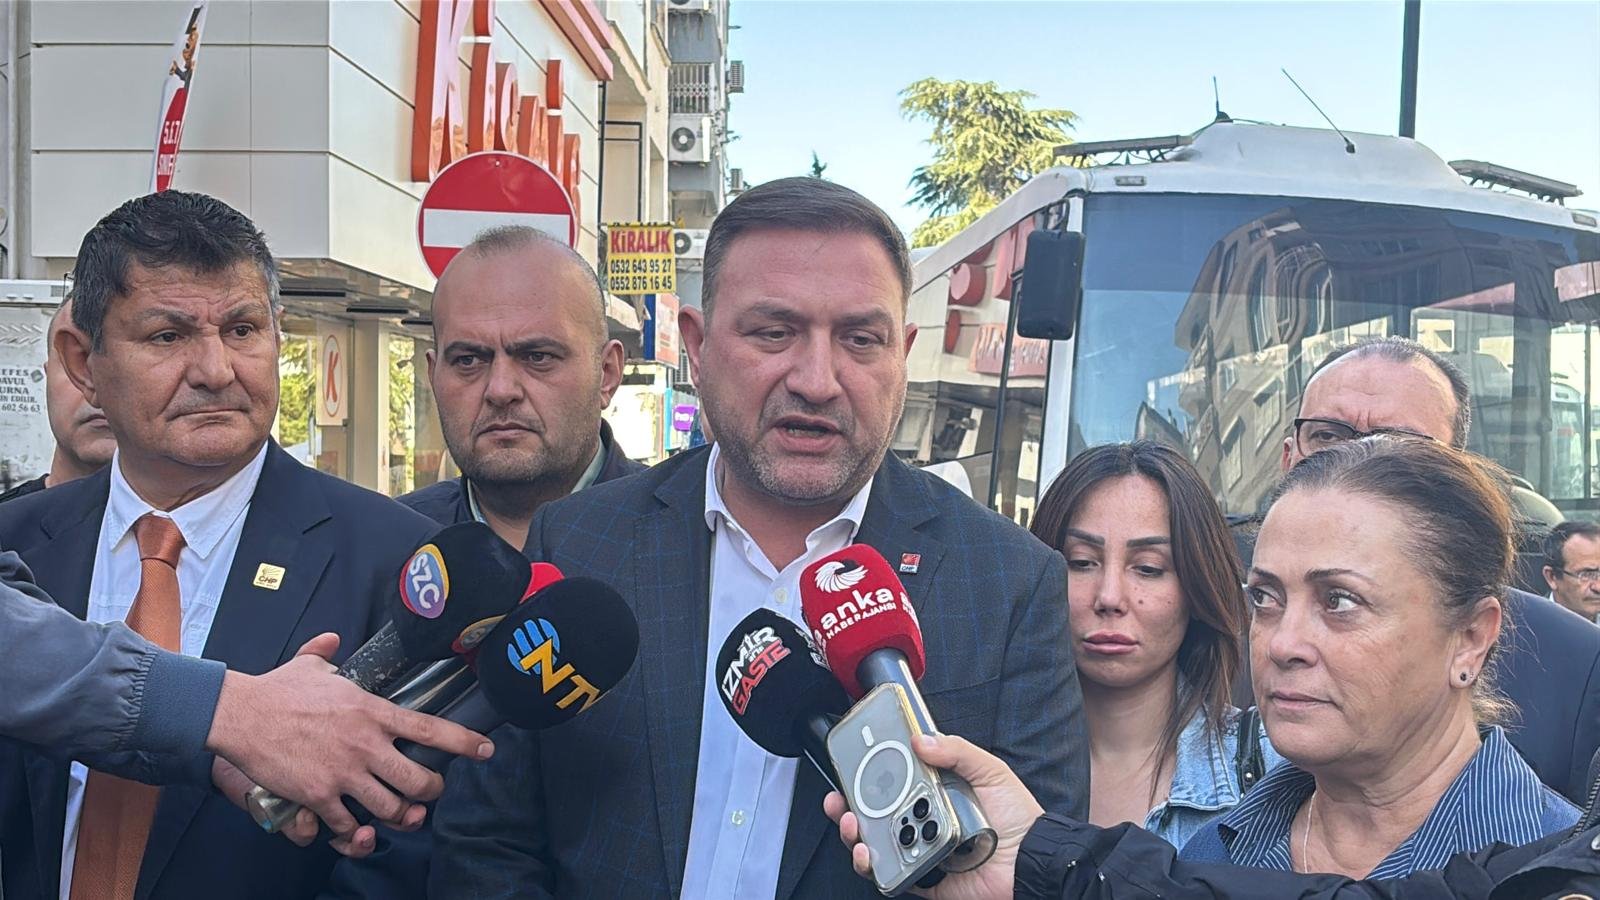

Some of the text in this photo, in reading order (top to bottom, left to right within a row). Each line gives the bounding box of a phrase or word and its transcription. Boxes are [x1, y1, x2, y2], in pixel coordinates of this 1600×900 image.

[610, 259, 672, 273] 0532 643 95 27
[610, 276, 672, 290] 0552 876 16 45
[326, 350, 339, 403] K
[408, 553, 441, 610] SZC
[820, 588, 895, 630] anka
[731, 638, 792, 716] GASTE
